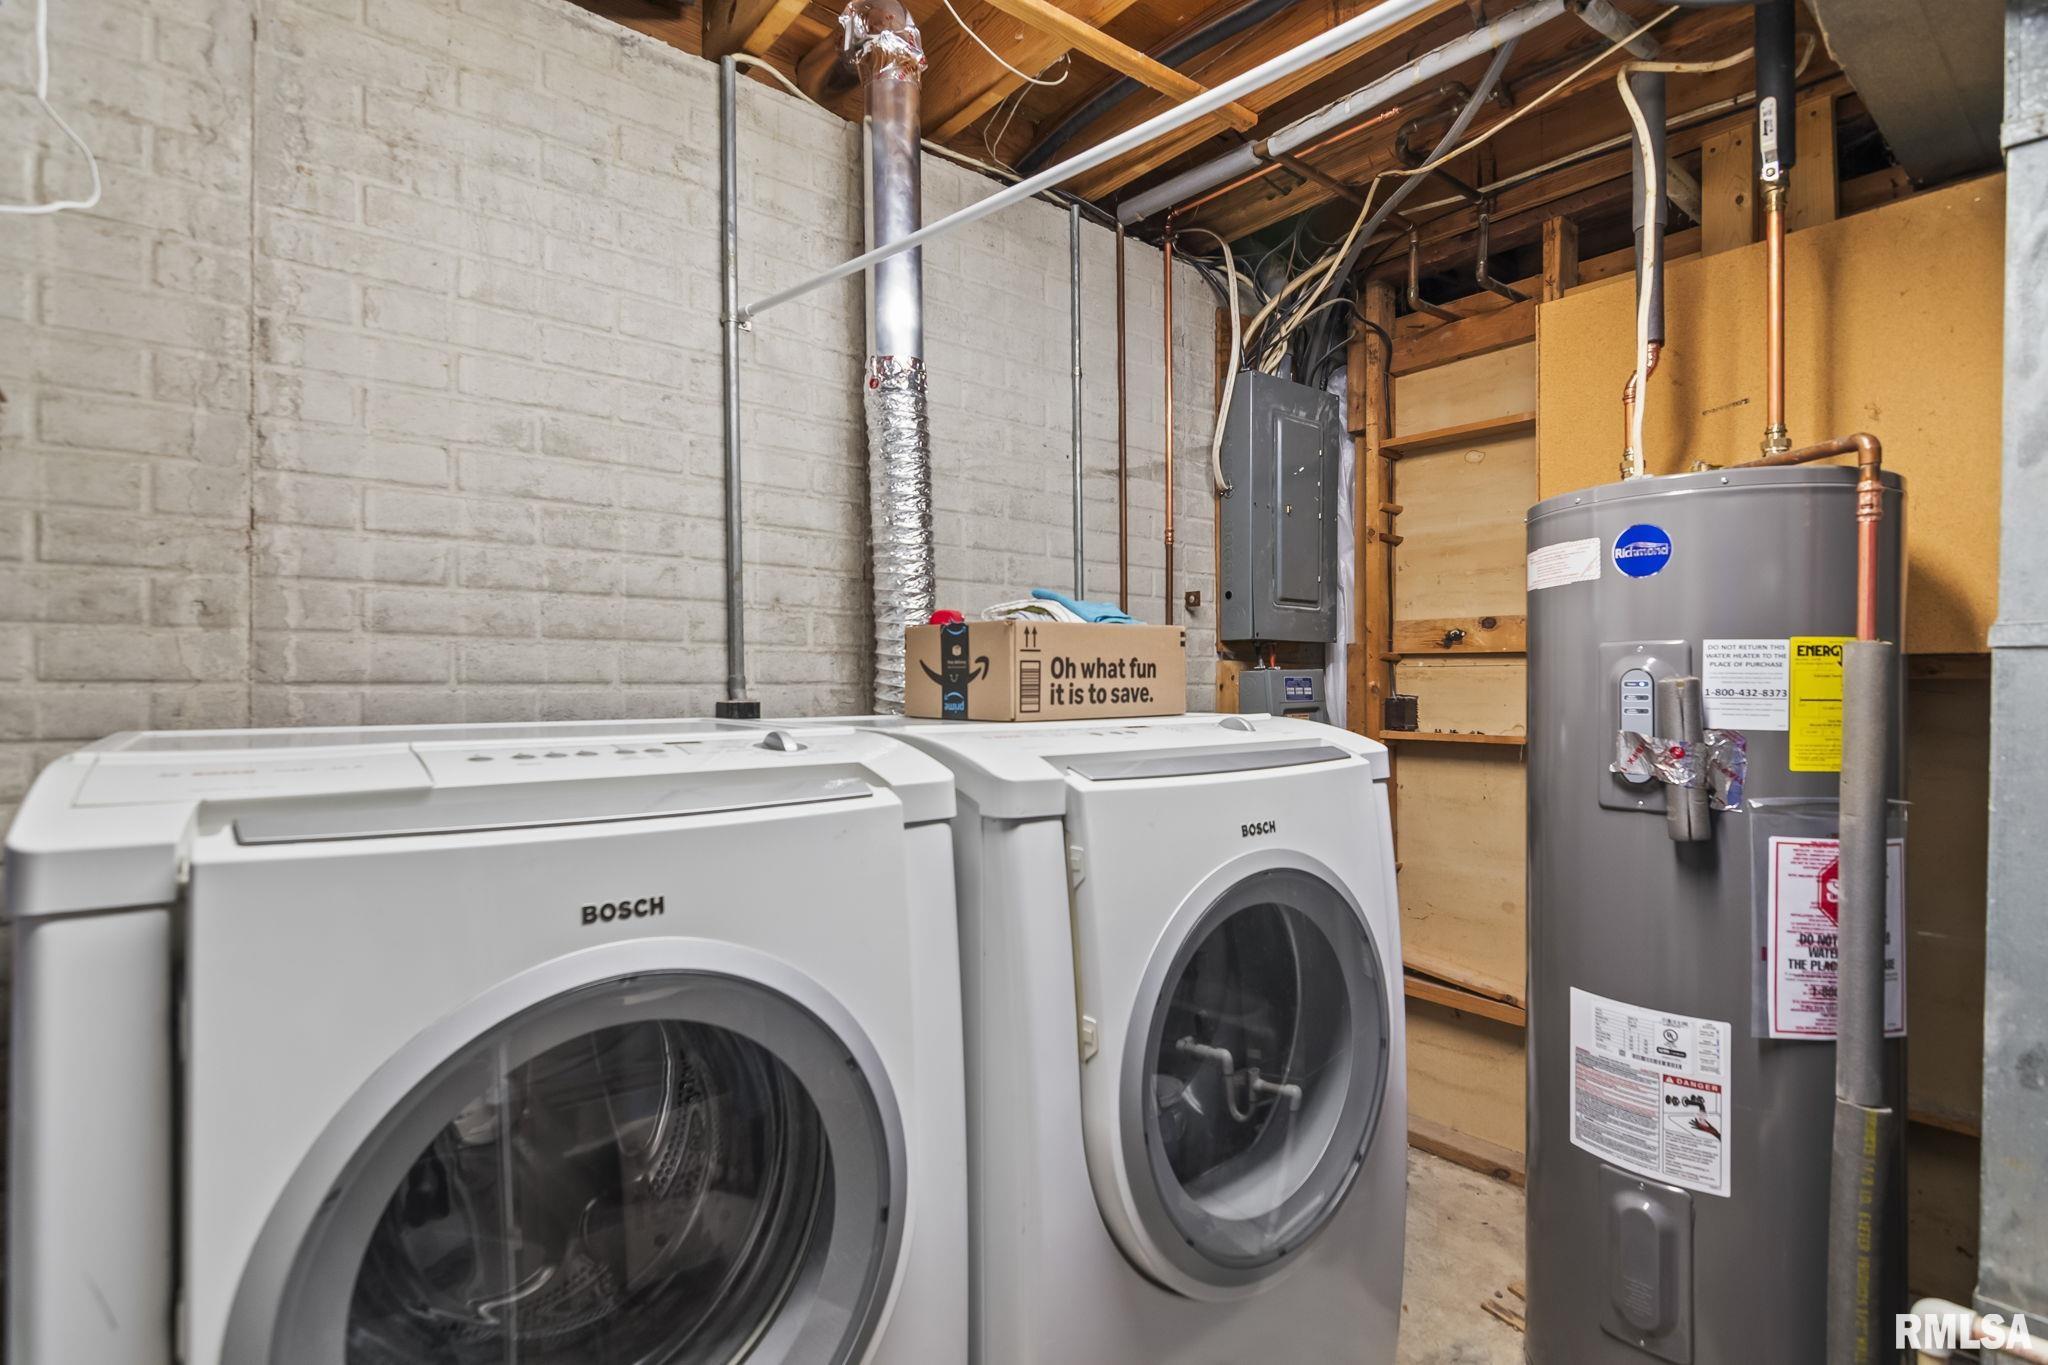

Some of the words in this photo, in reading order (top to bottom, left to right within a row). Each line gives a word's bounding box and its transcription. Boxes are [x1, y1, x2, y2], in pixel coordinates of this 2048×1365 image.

[1615, 543, 1669, 559] Richmond
[1050, 656, 1076, 679] Oh
[1081, 657, 1126, 679] what
[1129, 657, 1156, 678] fun
[1050, 682, 1064, 705] it
[1069, 682, 1084, 704] is
[1088, 683, 1107, 704] to
[1111, 686, 1153, 703] save.
[1705, 688, 1788, 697] 1-800-432-8373
[944, 700, 965, 714] prime
[1241, 820, 1276, 837] BOSCH
[581, 896, 664, 925] BOSCH
[1800, 934, 1815, 945] DO
[1817, 934, 1838, 945] NOT
[1809, 947, 1838, 958] WATE
[1788, 959, 1807, 970] THE
[1811, 960, 1838, 971] PLAC
[1676, 1078, 1719, 1092] DANGER
